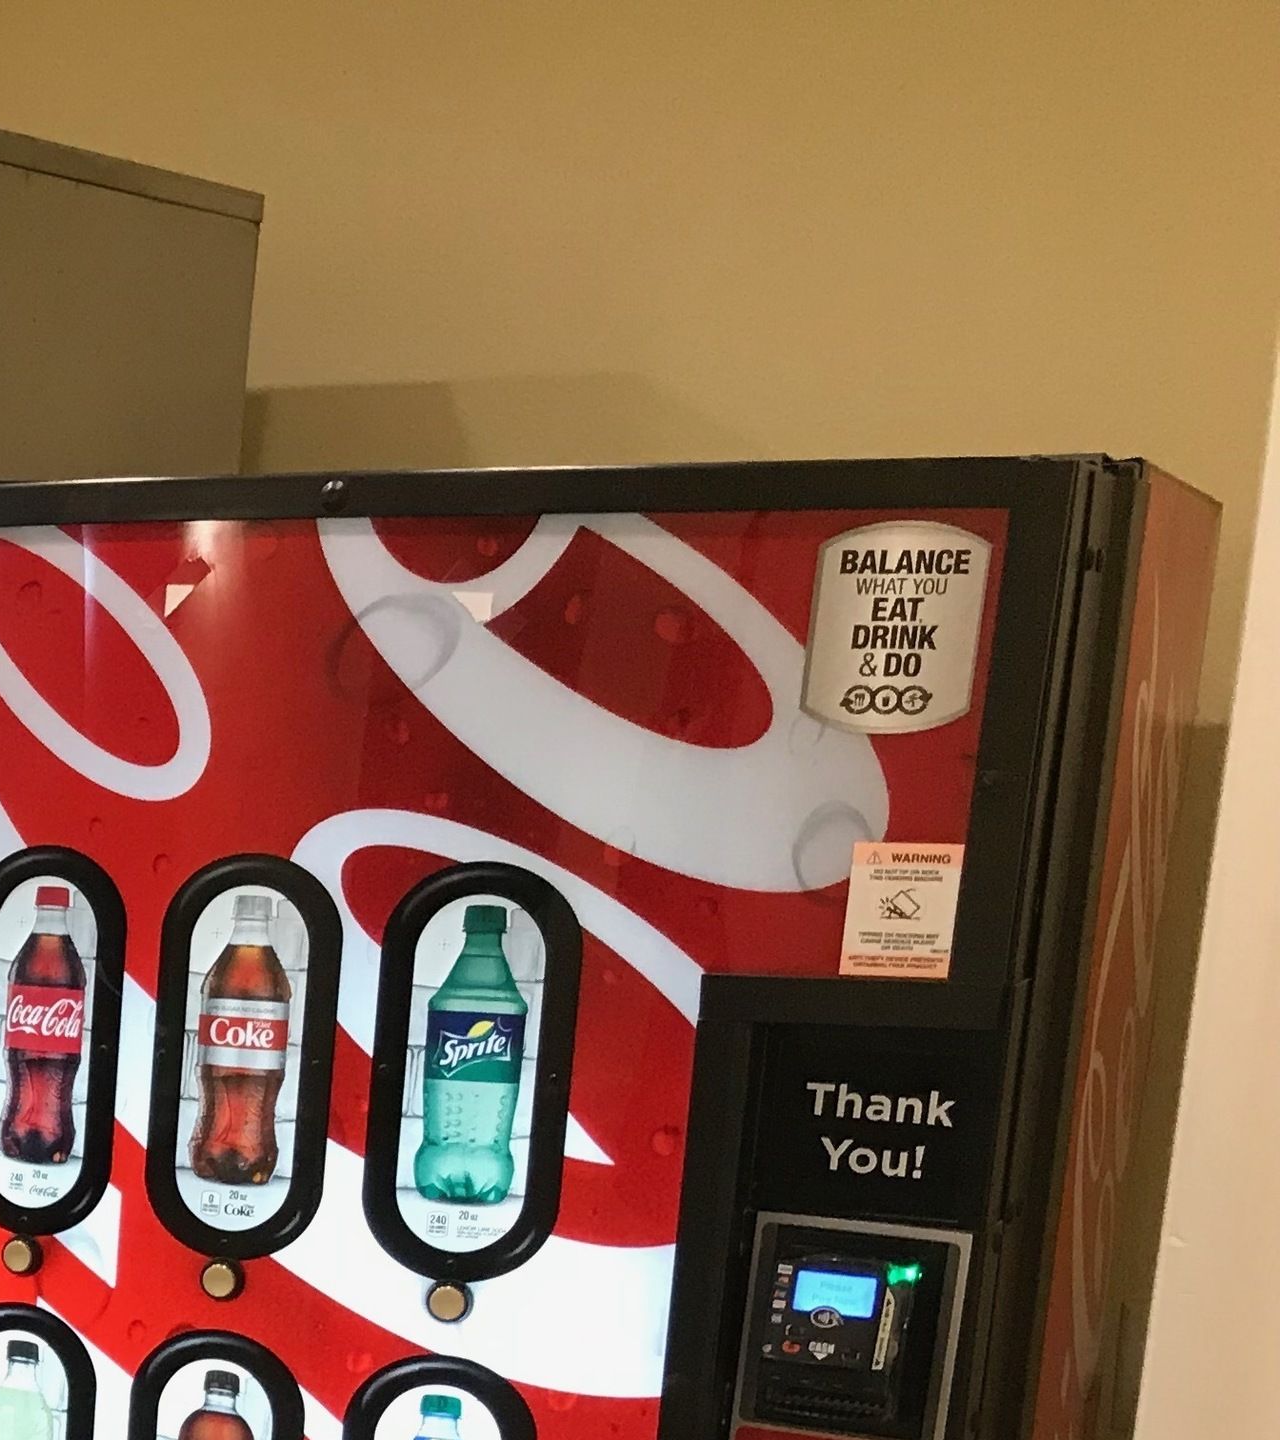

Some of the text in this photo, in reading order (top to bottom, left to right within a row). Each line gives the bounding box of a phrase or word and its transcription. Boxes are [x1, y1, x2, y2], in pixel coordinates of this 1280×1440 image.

[840, 549, 972, 575] BALANCE
[856, 578, 949, 595] WHAT YOU
[851, 624, 939, 650] DRINK
[858, 652, 922, 677] & DO
[891, 852, 952, 864] WARNING
[7, 995, 83, 1038] Coca-Cola
[210, 1018, 274, 1048] Coke
[439, 1030, 506, 1068] Sprite
[806, 1082, 956, 1128] Thank
[821, 1136, 926, 1179] You!
[229, 1189, 239, 1200] 20
[224, 1203, 255, 1217] Coke
[430, 1214, 447, 1225] 240
[459, 1210, 469, 1220] 20
